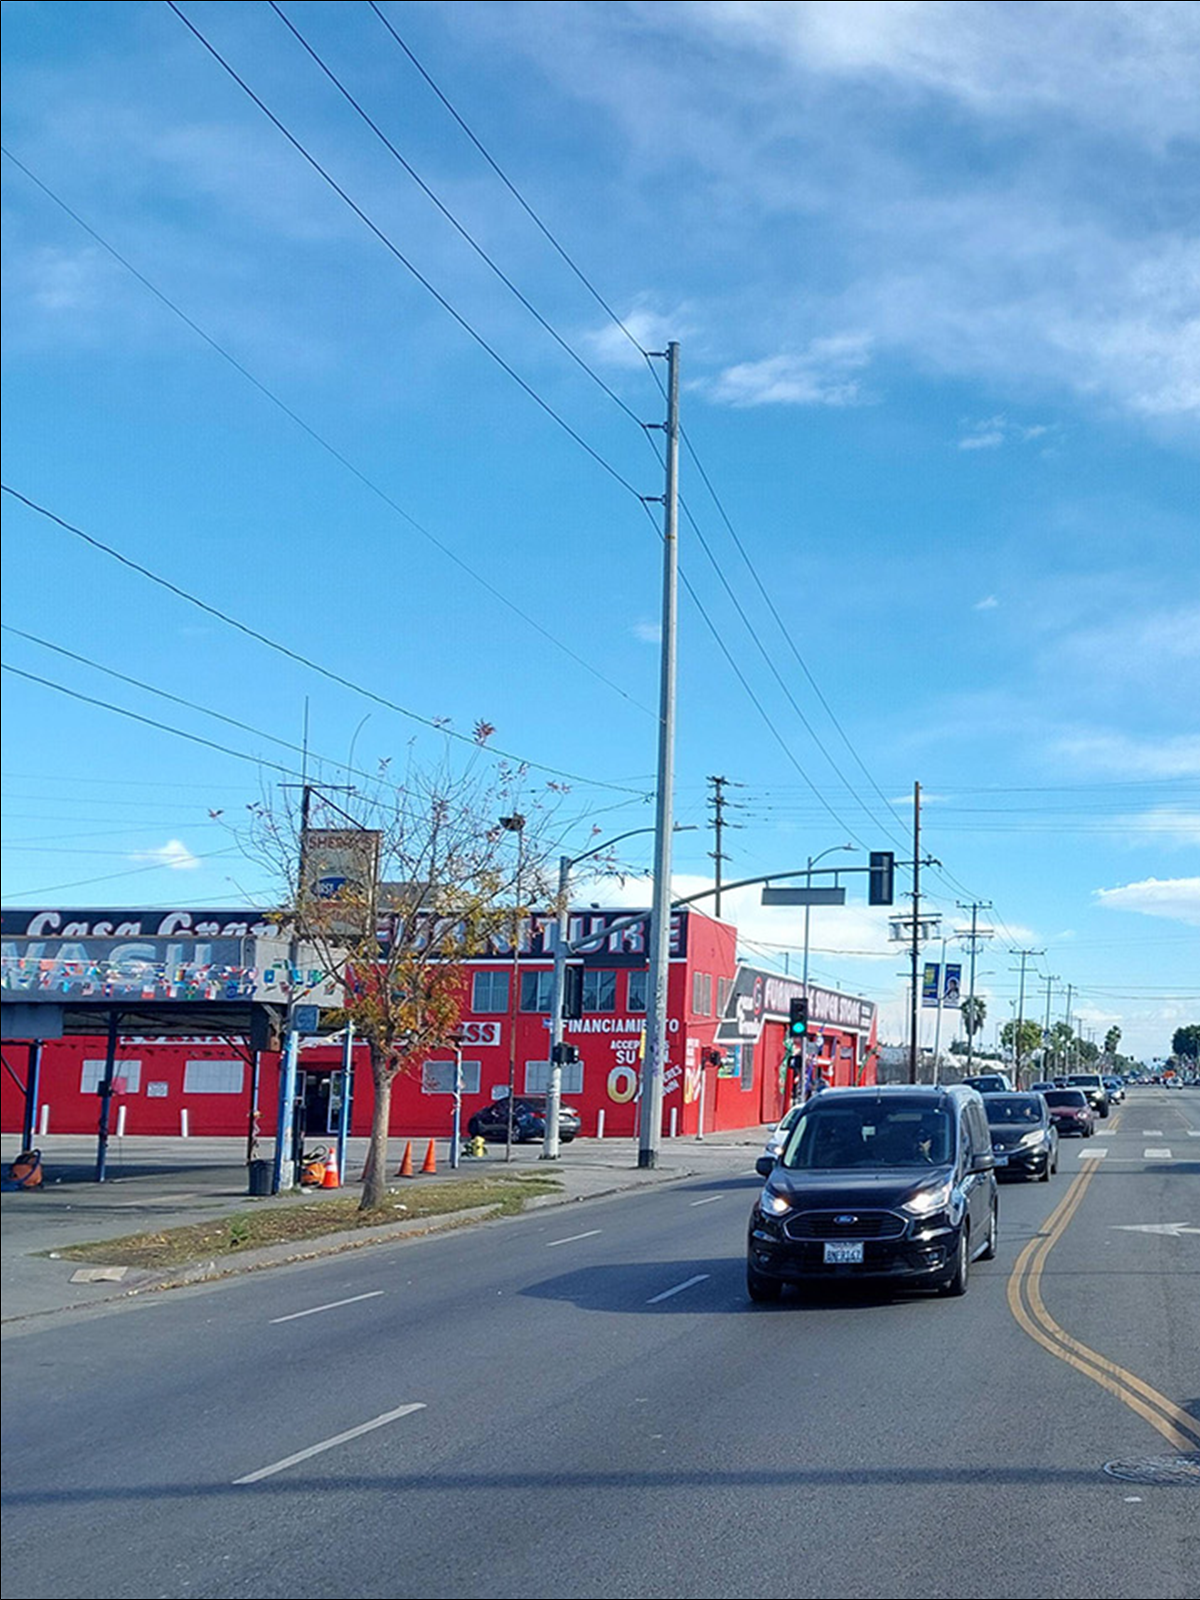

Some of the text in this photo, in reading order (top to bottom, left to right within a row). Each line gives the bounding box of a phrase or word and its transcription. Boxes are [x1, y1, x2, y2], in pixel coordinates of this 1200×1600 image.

[157, 911, 283, 936] Gran
[562, 1018, 679, 1033] FINANCIAMIEO
[616, 1050, 636, 1064] SU
